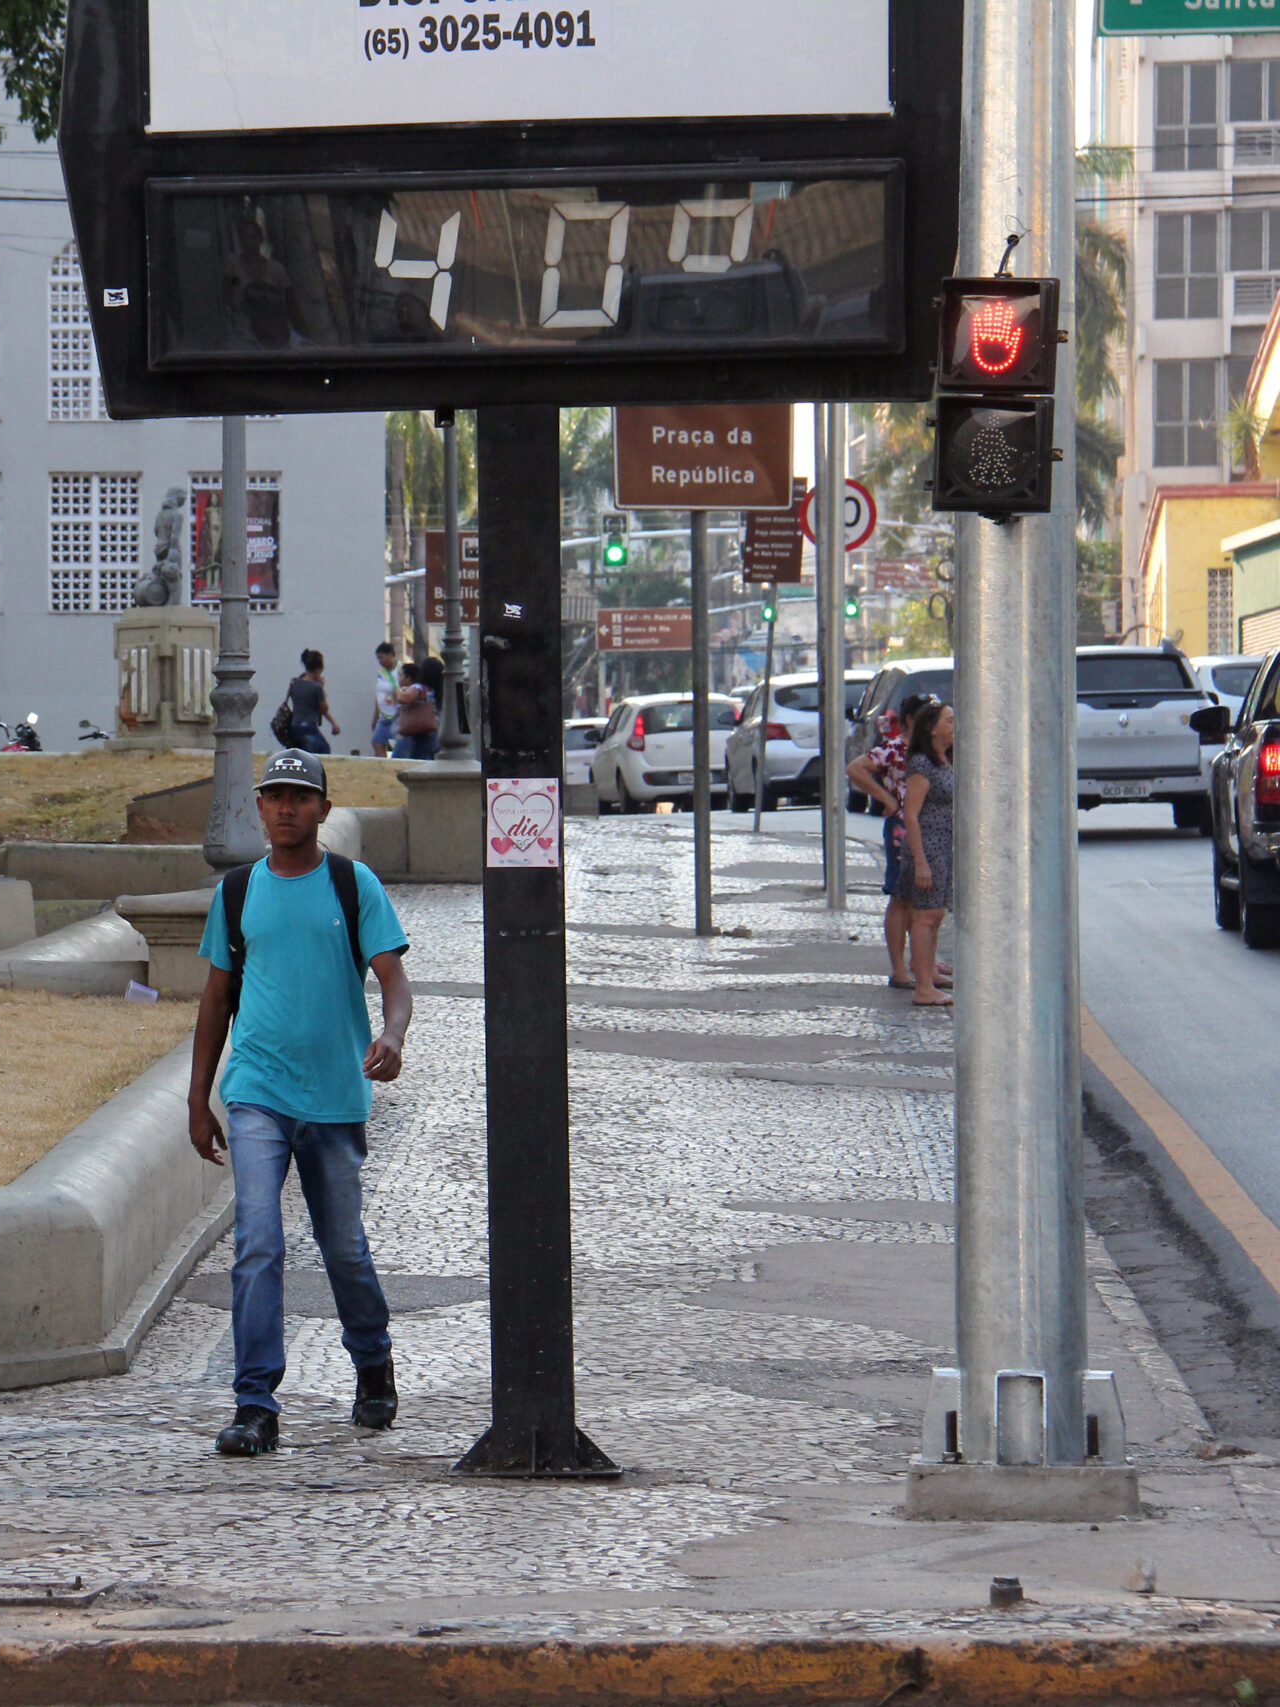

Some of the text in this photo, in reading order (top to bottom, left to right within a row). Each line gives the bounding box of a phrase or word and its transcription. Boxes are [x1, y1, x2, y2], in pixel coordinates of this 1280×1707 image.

[364, 10, 596, 61] (65) 3025-4091
[652, 426, 753, 448] Praça da
[651, 465, 755, 487] República
[507, 815, 539, 837] dia
